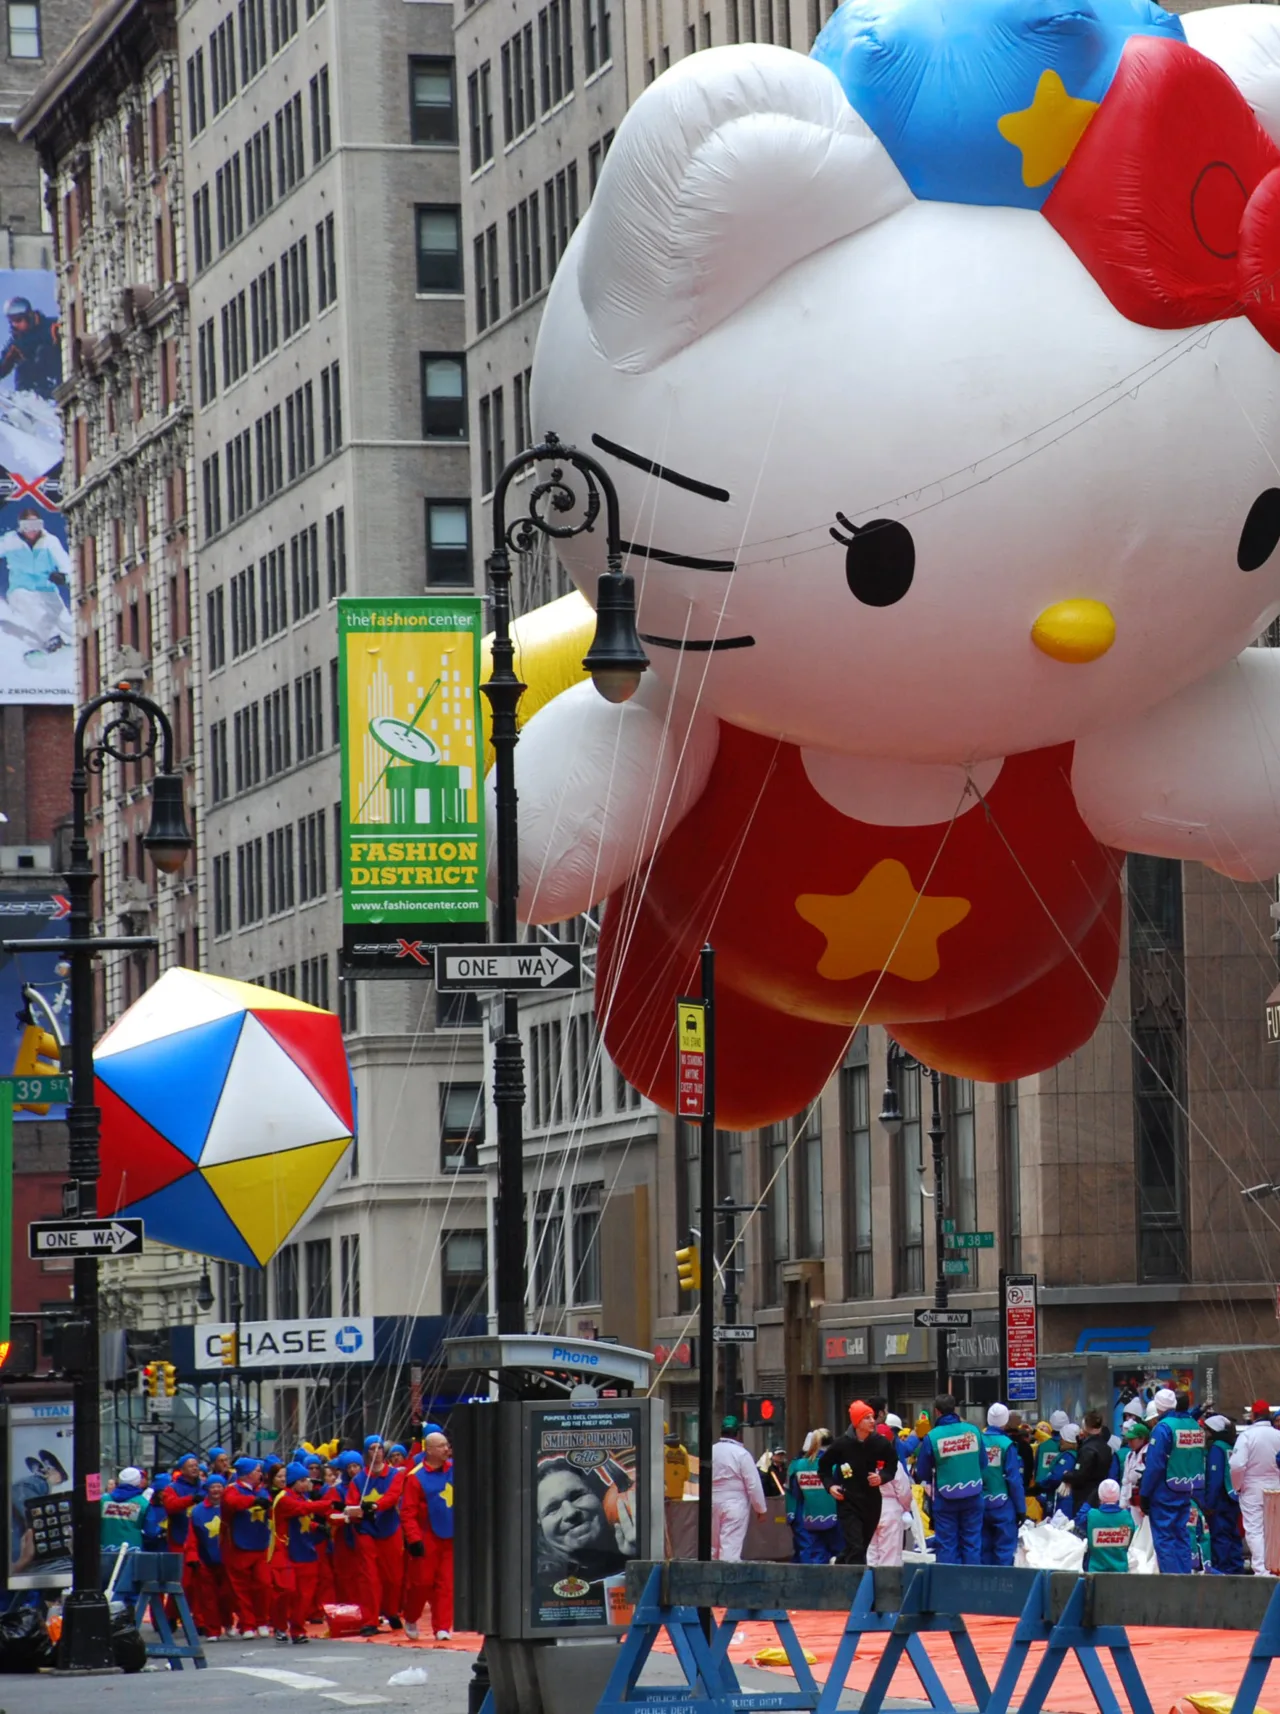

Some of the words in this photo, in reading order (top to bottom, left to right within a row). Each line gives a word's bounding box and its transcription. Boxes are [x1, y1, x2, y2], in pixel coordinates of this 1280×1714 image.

[346, 613, 472, 627] thefashioncenter
[350, 842, 478, 862] FASHION
[350, 866, 478, 885] DISTRICT
[351, 900, 479, 911] www.fashioncenter.com
[458, 959, 498, 976] ONE
[517, 958, 559, 975] WAY
[17, 1080, 42, 1099] 39
[51, 1079, 65, 1090] ST
[46, 1233, 78, 1246] ONE
[93, 1231, 126, 1245] WAY
[957, 1236, 964, 1246] W
[968, 1235, 981, 1246] 38
[923, 1314, 939, 1322] ONE
[947, 1313, 965, 1321] WAY
[552, 1347, 600, 1365] Phone
[32, 1406, 70, 1417] TITAN
[545, 1432, 584, 1448] SMILING
[585, 1431, 630, 1446] PUMPKIN
[574, 1449, 599, 1463] Ale
